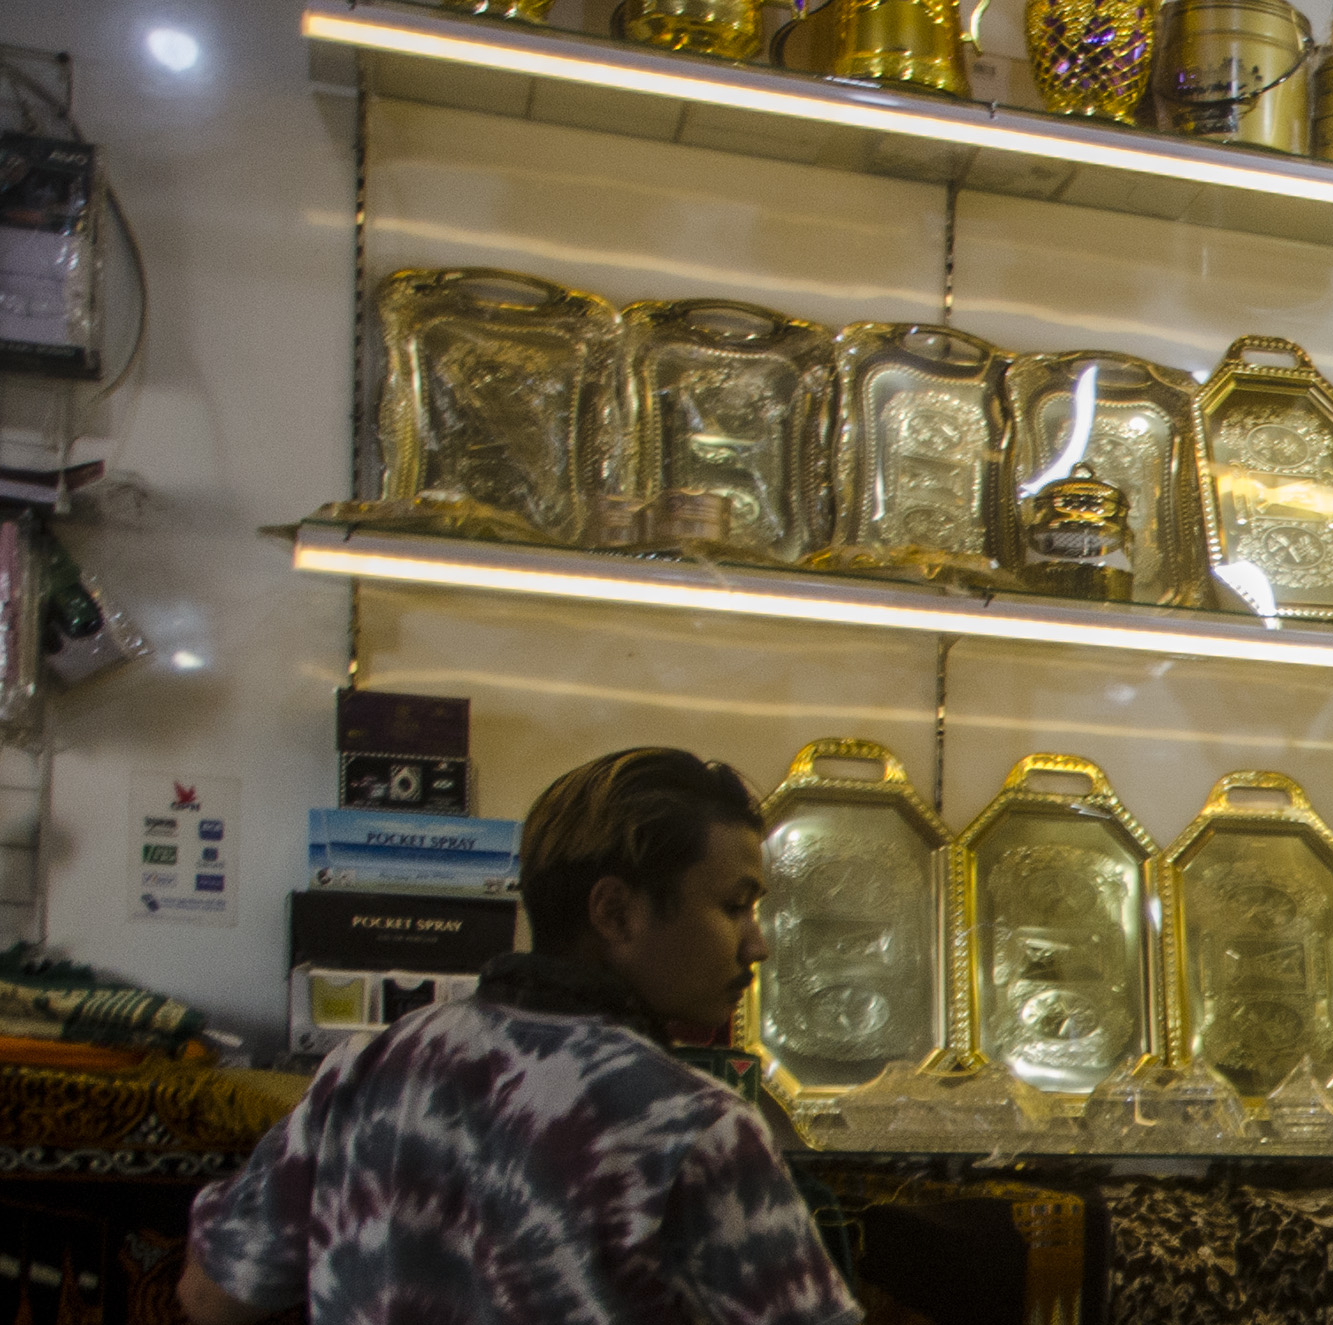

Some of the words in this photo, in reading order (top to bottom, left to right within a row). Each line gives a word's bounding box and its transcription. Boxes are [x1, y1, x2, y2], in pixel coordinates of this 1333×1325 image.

[366, 831, 426, 847] POCKET
[431, 834, 478, 850] SPRAY
[352, 915, 412, 930] POCKET
[416, 918, 464, 933] SPRAY
